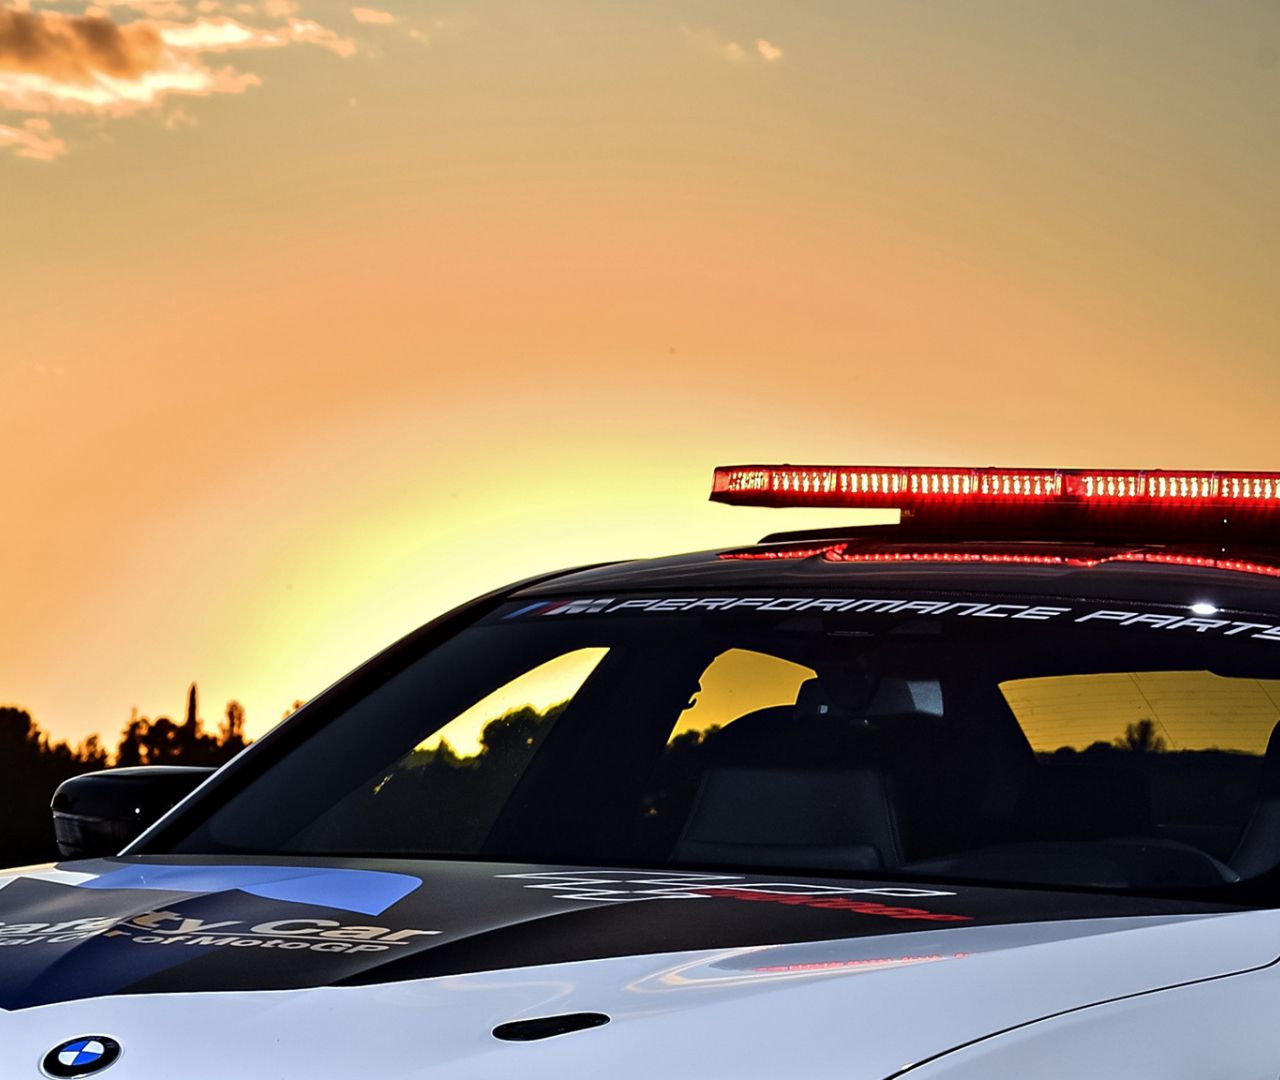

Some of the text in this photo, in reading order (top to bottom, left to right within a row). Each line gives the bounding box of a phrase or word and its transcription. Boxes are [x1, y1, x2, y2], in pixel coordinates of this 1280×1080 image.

[604, 597, 1072, 620] PERFORMANCE
[250, 918, 444, 941] Car
[187, 936, 391, 954] MotoGP
